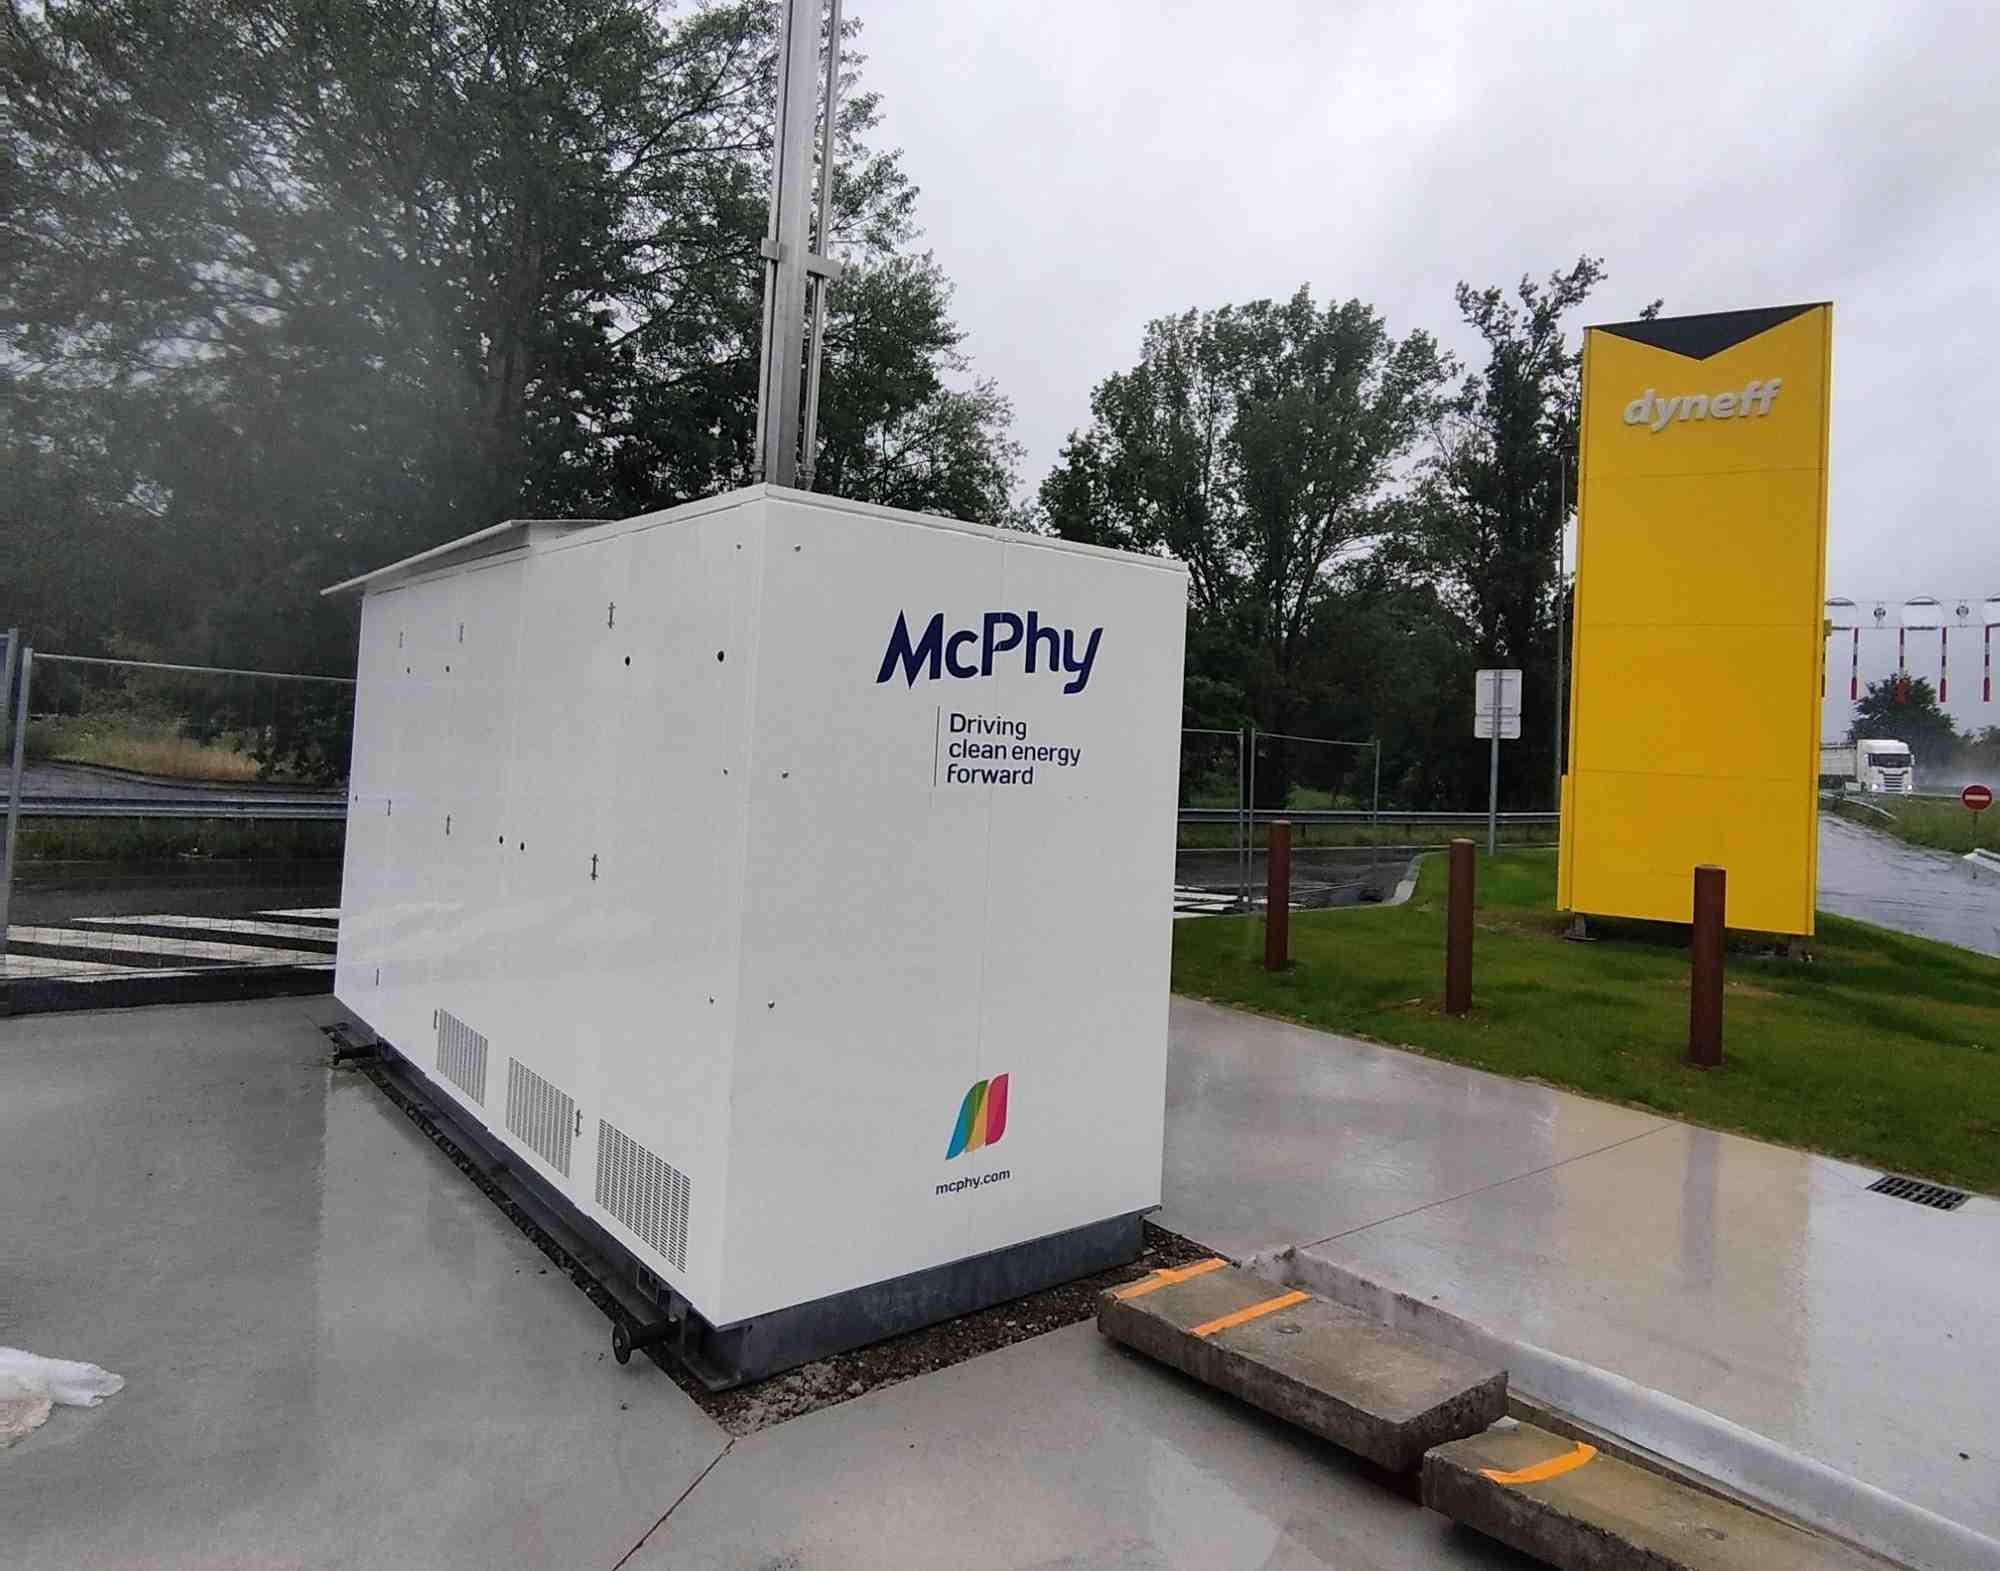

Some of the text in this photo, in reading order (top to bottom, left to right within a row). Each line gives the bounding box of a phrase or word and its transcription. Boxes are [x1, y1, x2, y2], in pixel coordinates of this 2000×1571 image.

[1623, 377, 1782, 434] dyneff
[876, 608, 1104, 695] McPhy
[949, 712, 1027, 741] Driving
[948, 738, 1081, 767] clean energy
[946, 763, 1034, 785] forward
[935, 1169, 1011, 1195] mcphy.com
